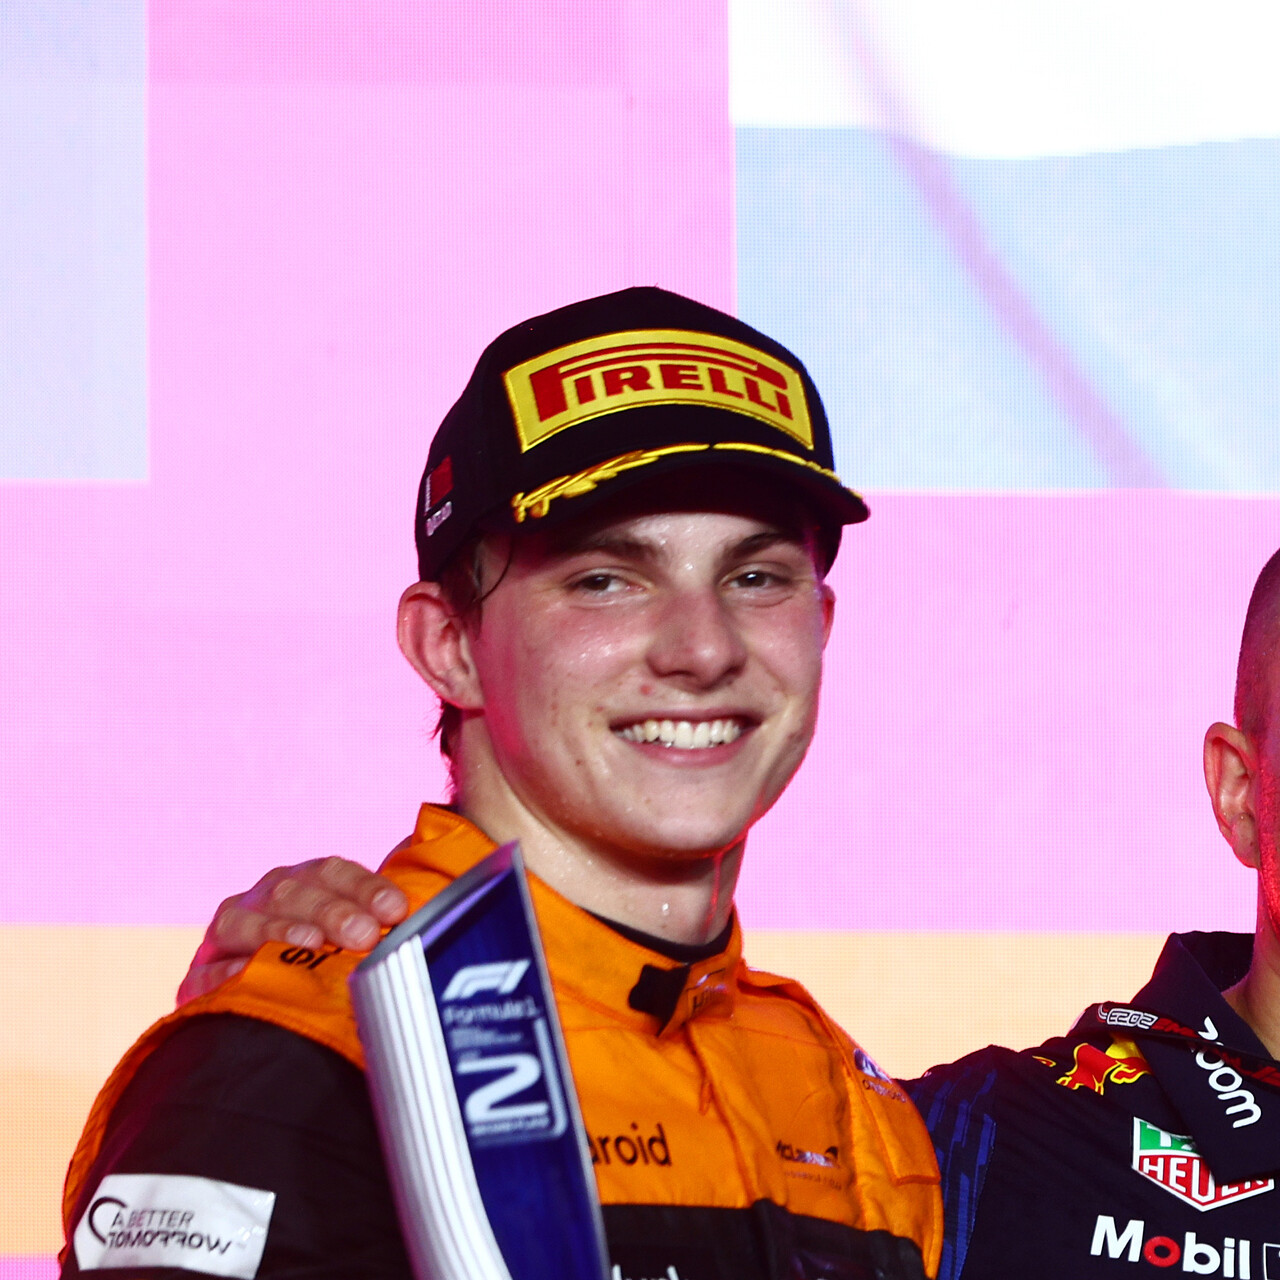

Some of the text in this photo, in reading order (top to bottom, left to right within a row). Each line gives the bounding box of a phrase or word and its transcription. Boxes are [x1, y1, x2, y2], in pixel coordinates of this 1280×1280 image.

[529, 342, 793, 422] PIRELLI
[457, 1053, 549, 1123] 2
[126, 1210, 194, 1228] BETTER
[1090, 1215, 1251, 1280] Mobil
